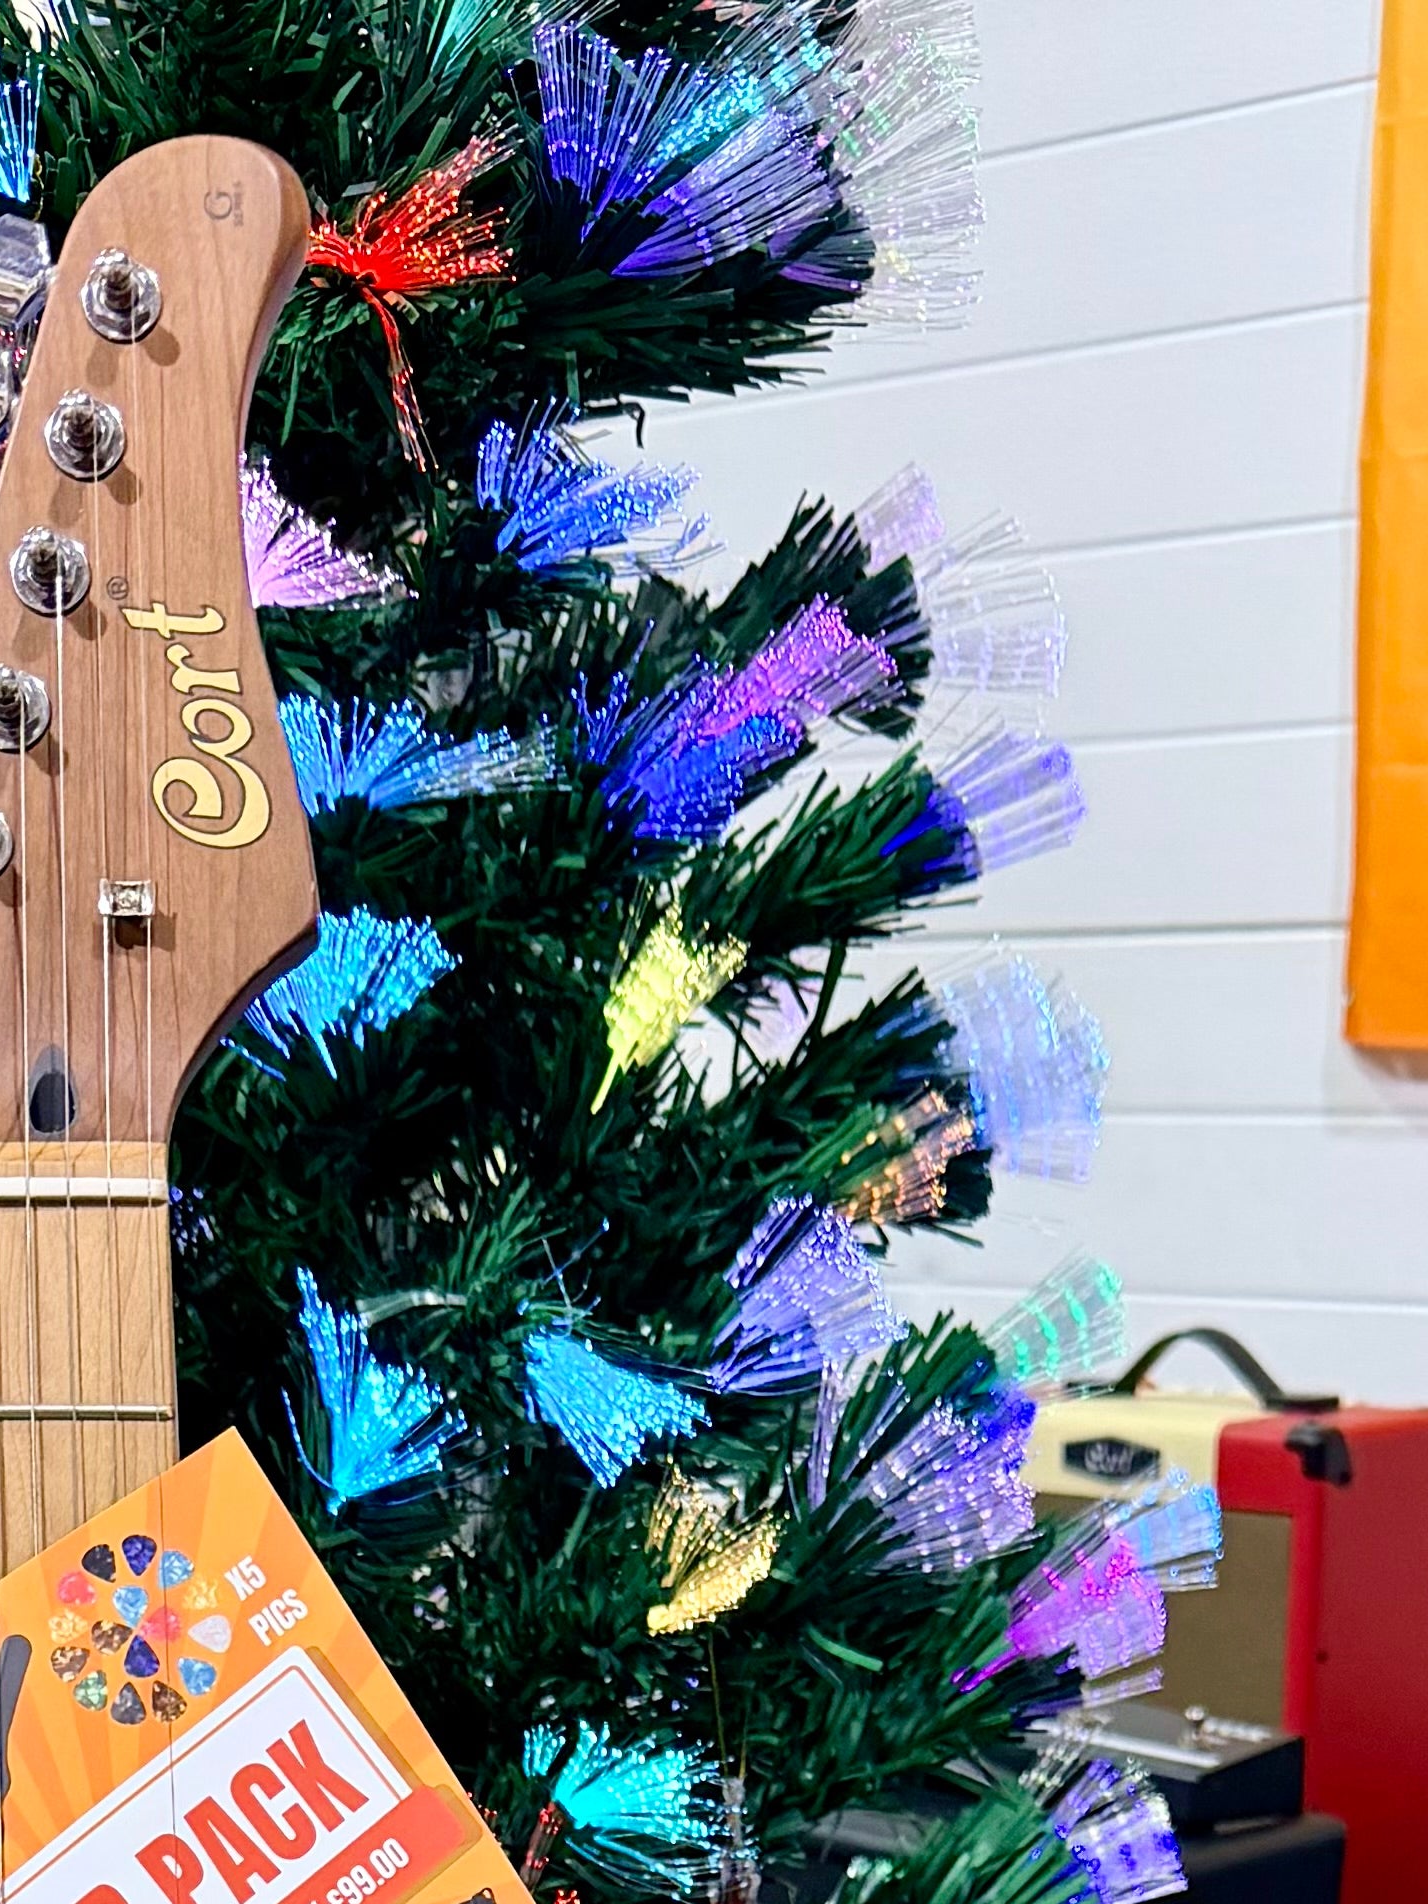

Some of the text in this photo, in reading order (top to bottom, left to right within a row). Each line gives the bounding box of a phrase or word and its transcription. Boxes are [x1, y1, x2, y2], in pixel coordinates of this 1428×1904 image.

[121, 603, 273, 850] Cort
[225, 1556, 267, 1601] X5
[248, 1588, 310, 1648] PICS
